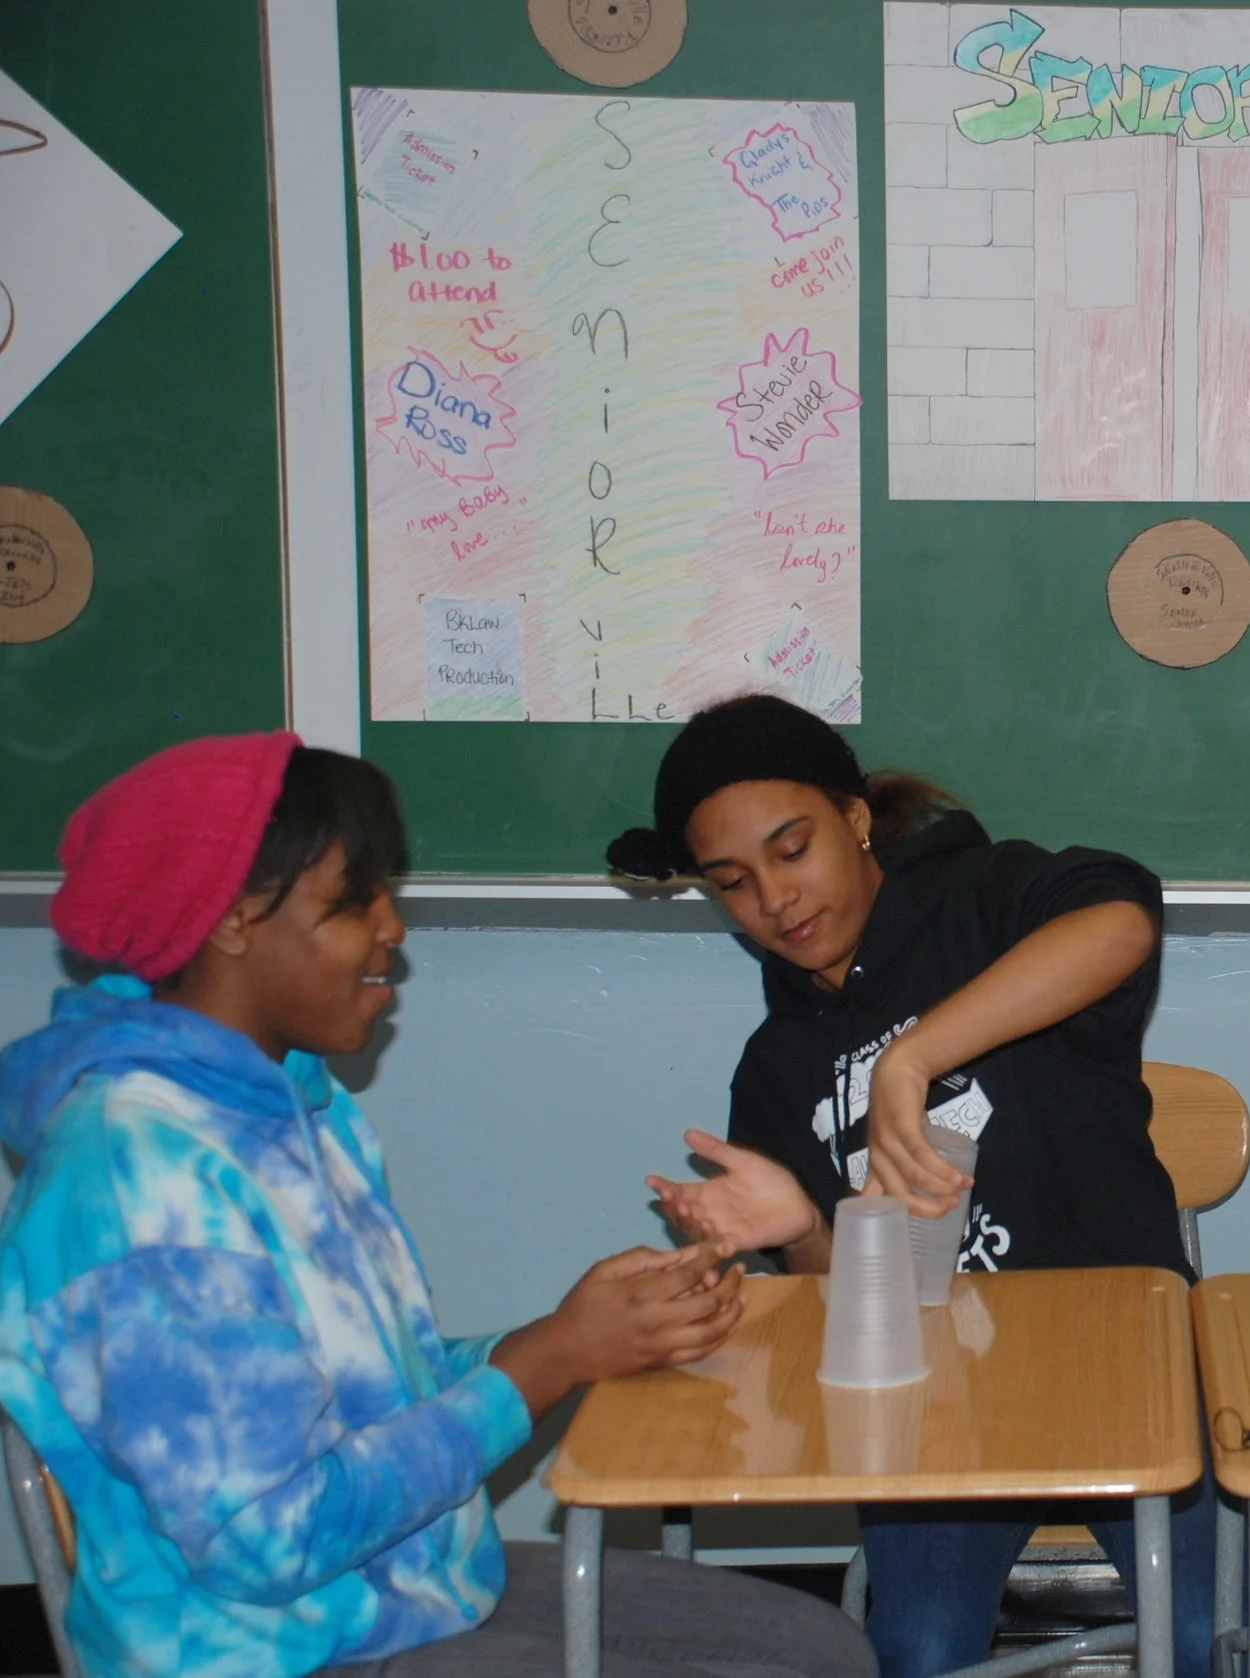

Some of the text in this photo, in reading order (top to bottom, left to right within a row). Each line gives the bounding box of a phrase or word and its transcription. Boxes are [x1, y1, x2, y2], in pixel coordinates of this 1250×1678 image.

[739, 133, 791, 169] Gladys
[770, 193, 800, 213] The
[802, 197, 829, 218] Pips
[389, 241, 513, 272] $100 to
[811, 236, 845, 275] join
[408, 280, 497, 304] attend
[395, 360, 492, 430] Diana
[735, 355, 808, 422] Stevie
[405, 404, 468, 455] Ross
[815, 517, 846, 535] she
[440, 638, 484, 655] Tech
[851, 1030, 893, 1062] CLASS OF
